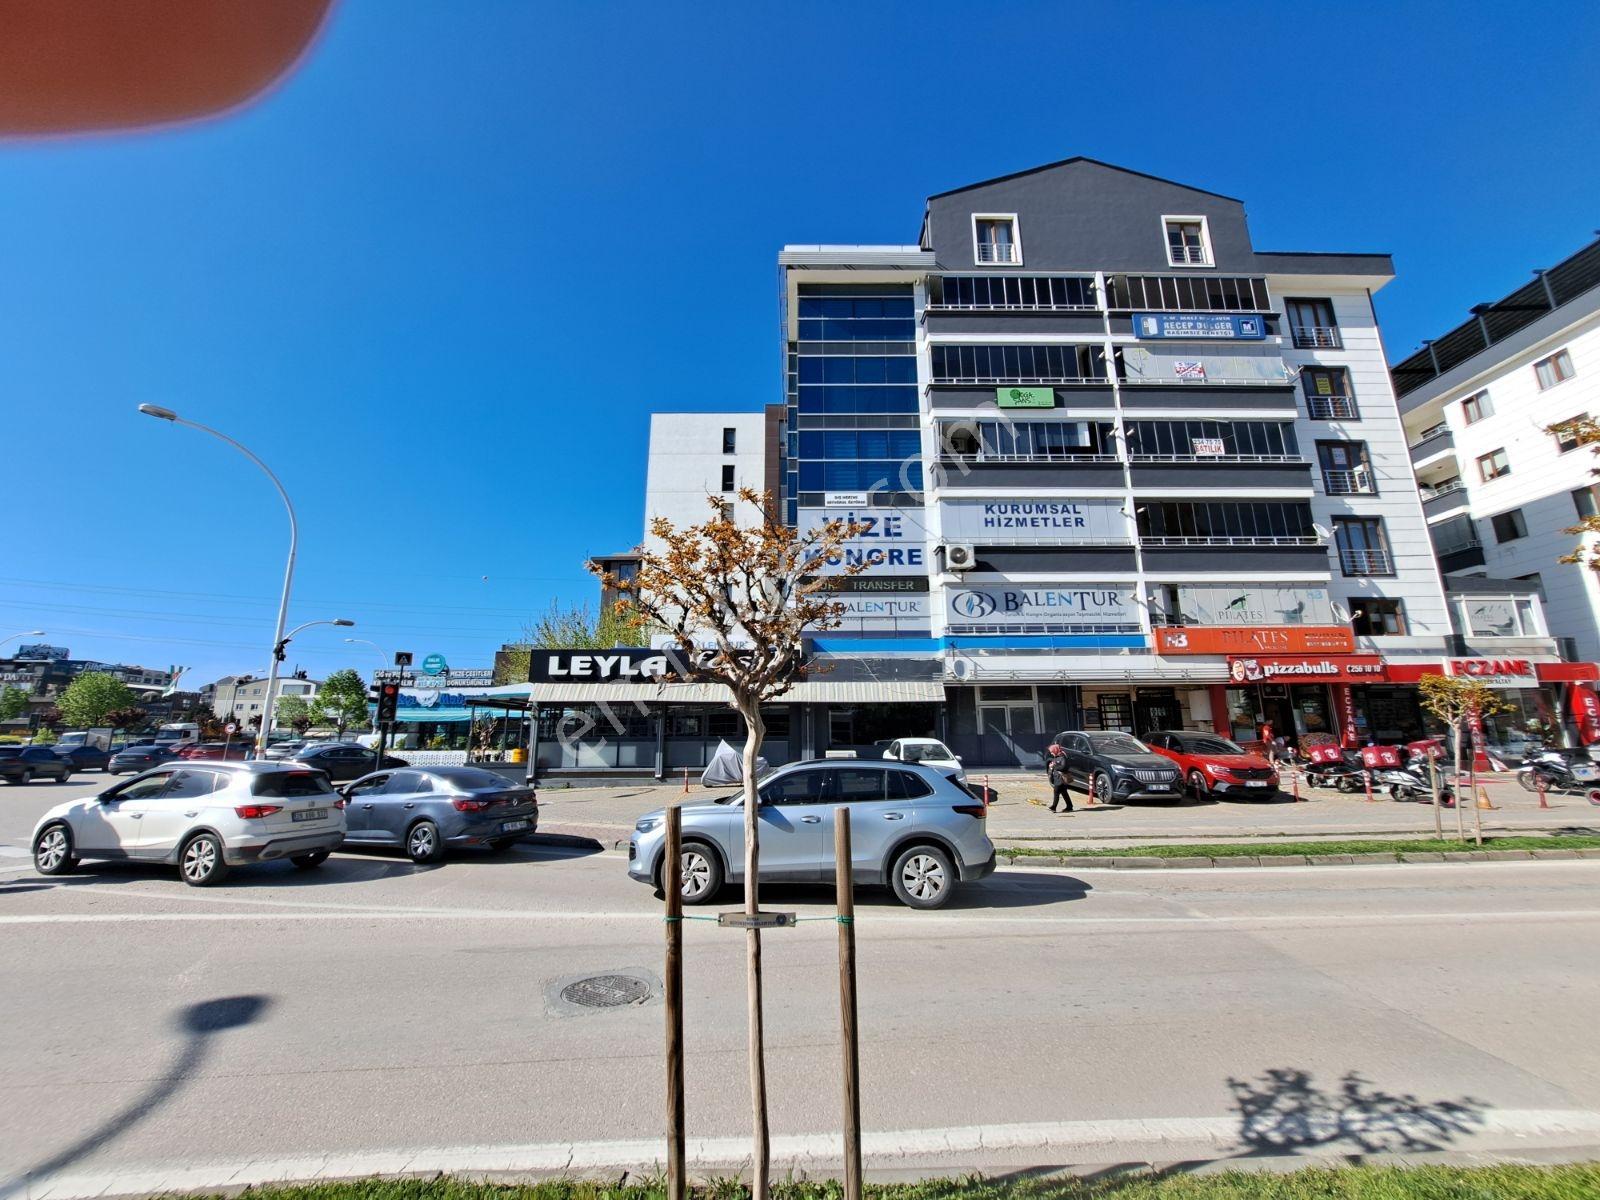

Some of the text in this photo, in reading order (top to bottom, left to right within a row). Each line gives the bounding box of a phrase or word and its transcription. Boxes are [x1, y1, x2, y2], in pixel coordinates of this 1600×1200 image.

[1164, 322, 1194, 330] RECEP
[985, 504, 1082, 515] KURUMSAL
[984, 515, 1085, 527] HİZMETLER
[853, 581, 914, 589] TRANSFER
[1003, 591, 1122, 611] BALENTUR
[1218, 610, 1263, 623] PILATES
[548, 655, 667, 677] LEYLA
[1264, 661, 1338, 677] pizzabulls
[1450, 660, 1530, 676] ECZANE
[1344, 688, 1356, 741] ECZANE
